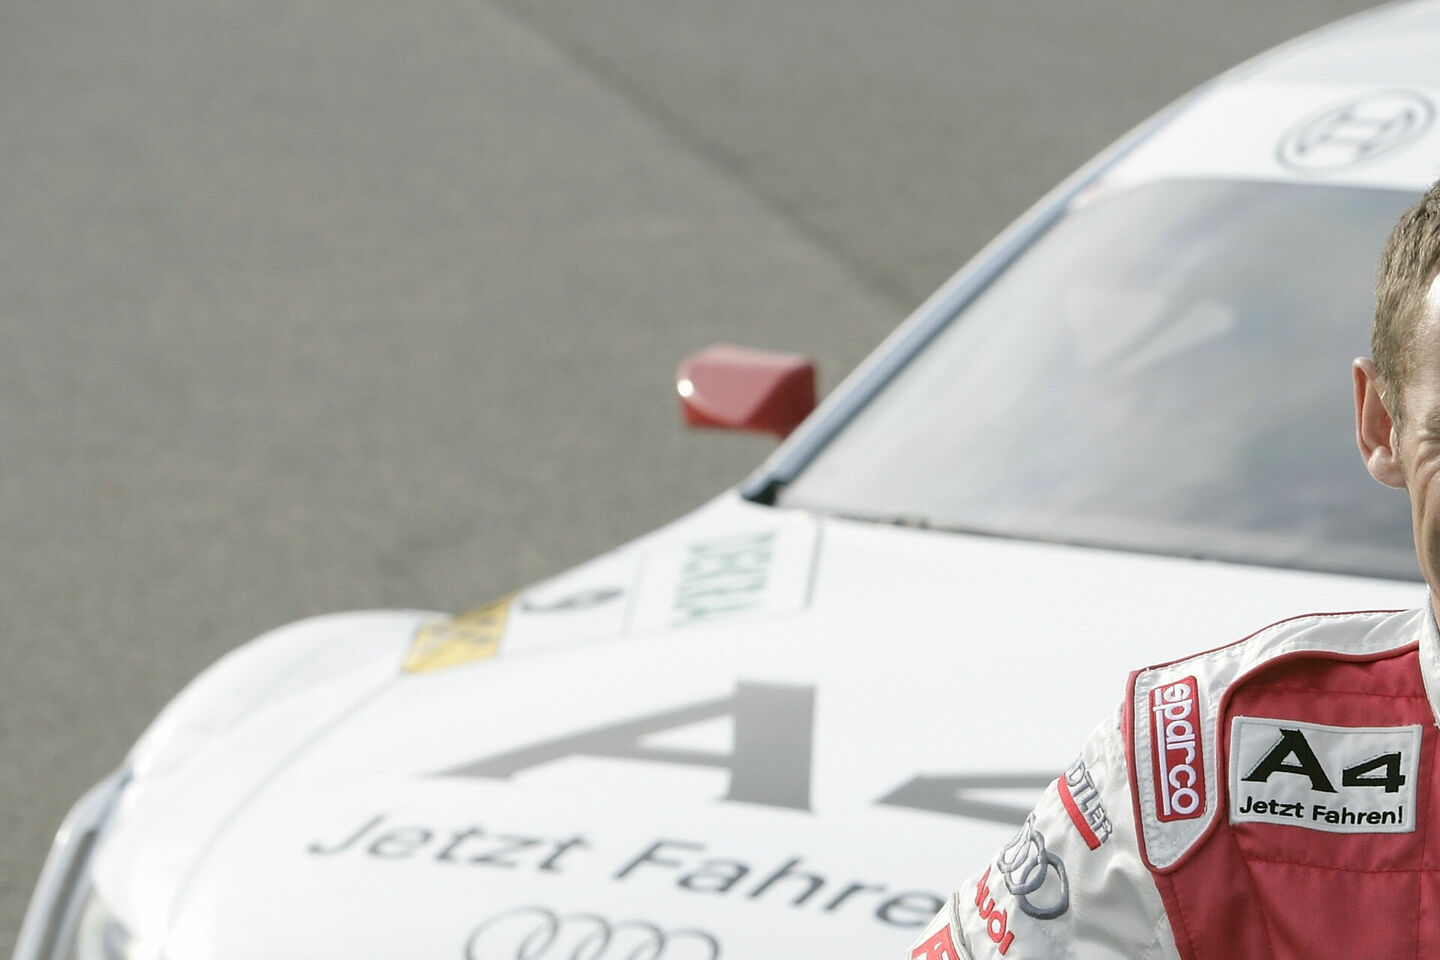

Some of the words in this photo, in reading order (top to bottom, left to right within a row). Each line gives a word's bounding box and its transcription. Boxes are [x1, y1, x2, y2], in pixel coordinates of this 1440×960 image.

[1152, 682, 1201, 817] sparco
[1240, 727, 1406, 794] A4
[306, 812, 590, 873] Jetzt
[1239, 795, 1305, 819] Jetzt
[1312, 804, 1404, 826] Fahren!
